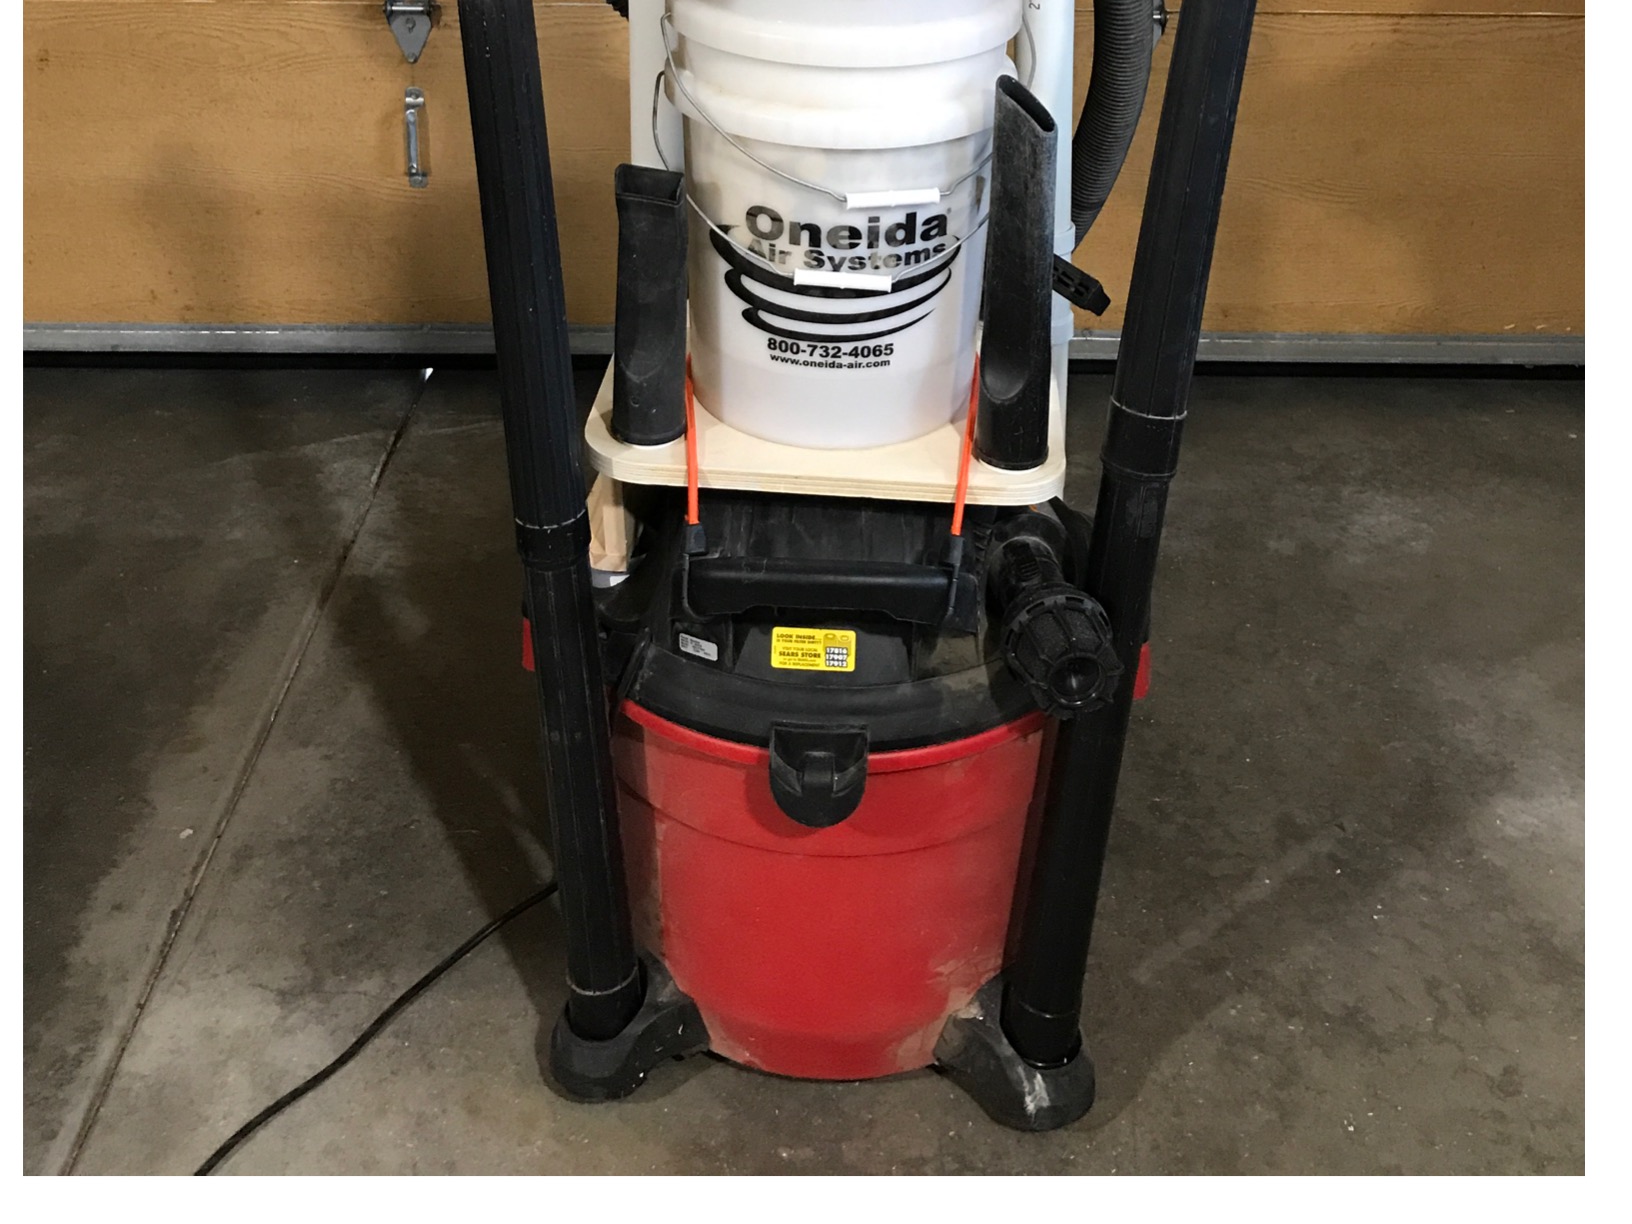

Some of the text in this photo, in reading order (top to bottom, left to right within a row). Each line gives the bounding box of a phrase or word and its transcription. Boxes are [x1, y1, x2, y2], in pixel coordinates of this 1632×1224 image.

[745, 205, 948, 250] Oneida
[745, 238, 947, 272] Air Systems
[767, 337, 894, 359] 800-732-4065
[770, 354, 891, 369] www.oneida-air.com
